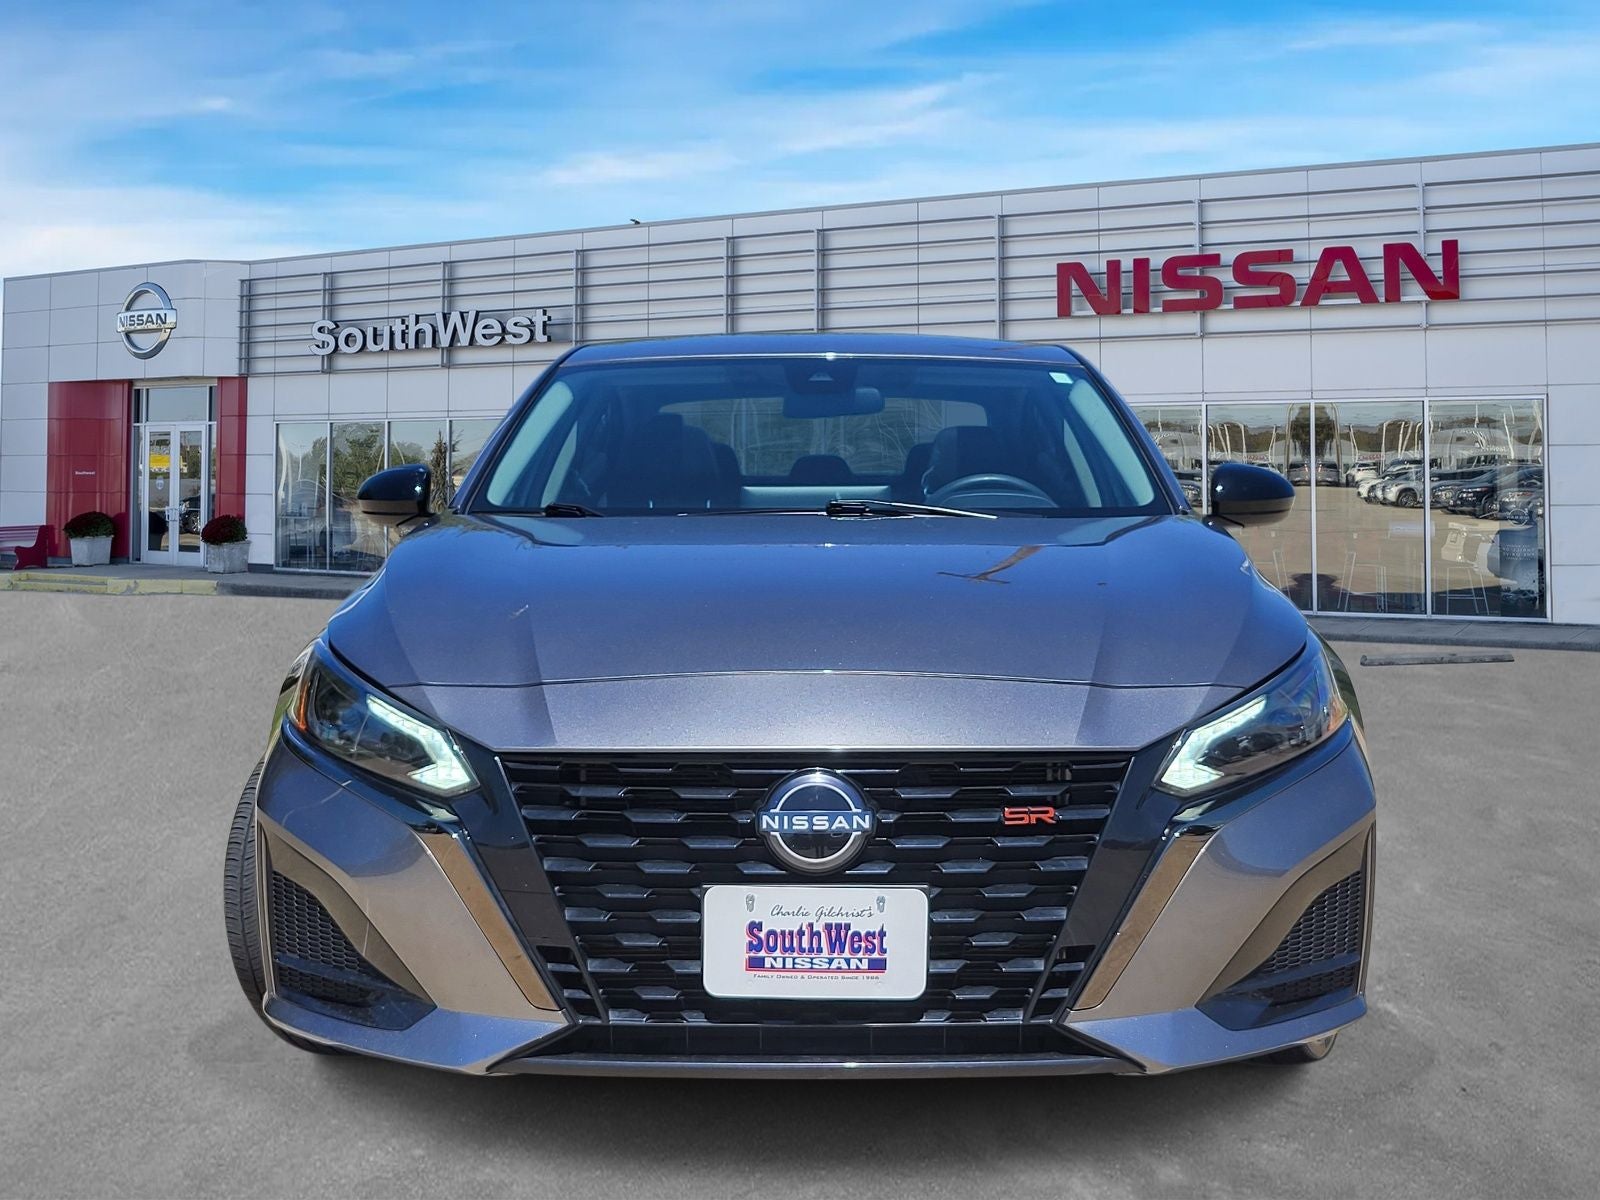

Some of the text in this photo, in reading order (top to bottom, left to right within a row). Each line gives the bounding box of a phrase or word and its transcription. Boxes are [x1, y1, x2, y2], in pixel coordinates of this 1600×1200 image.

[1056, 239, 1460, 318] NISSAN
[118, 312, 168, 328] NISSAN
[308, 308, 551, 356] SouthWest
[761, 814, 870, 831] NISSAN
[1003, 806, 1056, 825] SR
[770, 904, 874, 923] Charlie Gilchrist's
[745, 920, 887, 956] SouthWest
[764, 957, 869, 969] NISSAN
